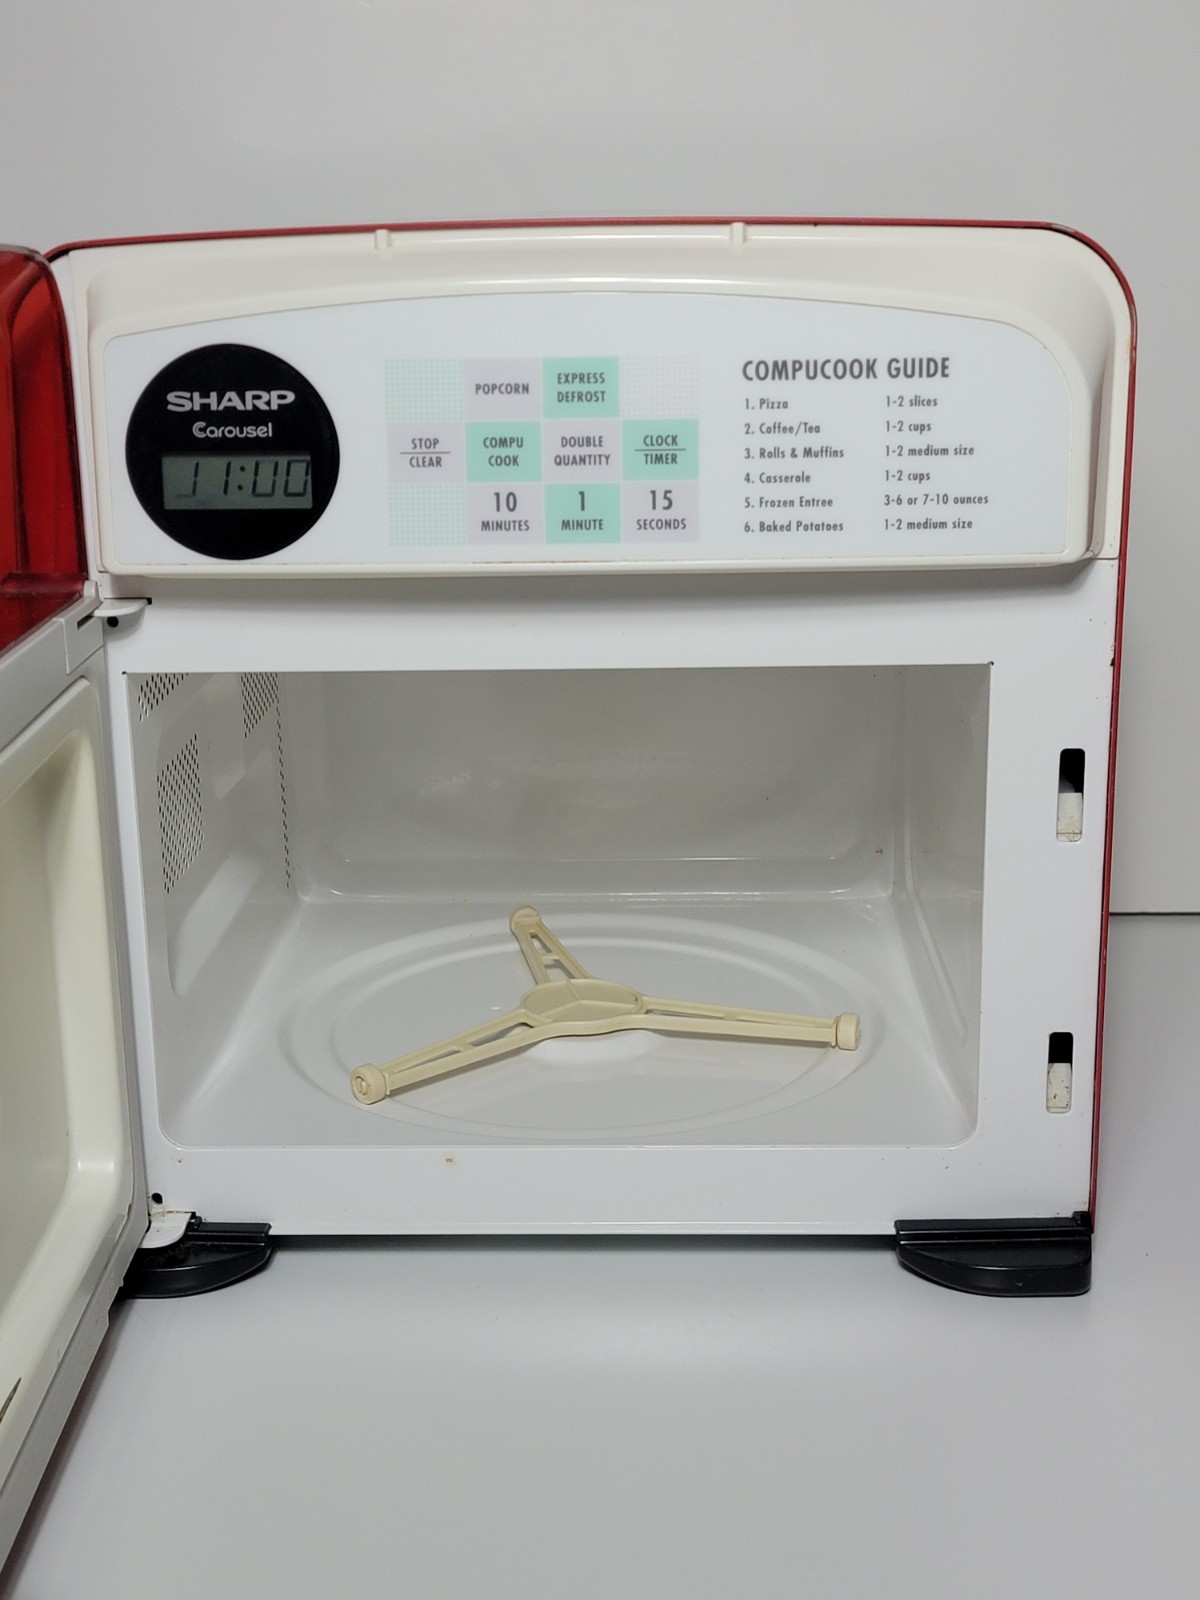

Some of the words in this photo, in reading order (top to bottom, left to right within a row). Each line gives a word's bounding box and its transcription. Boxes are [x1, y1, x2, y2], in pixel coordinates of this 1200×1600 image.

[742, 359, 878, 381] COMPUCOOK
[887, 357, 950, 379] GUIDE
[557, 372, 605, 385] EXPRESS
[475, 383, 529, 395] POPCORN
[167, 390, 295, 412] SHARP
[557, 391, 606, 403] DEFROST
[886, 396, 904, 407] 1-2
[909, 396, 938, 407] slices
[744, 399, 755, 410] 1.
[759, 399, 789, 410] Pizza
[192, 421, 272, 438] Carousel
[744, 423, 755, 435] 2.
[759, 421, 821, 436] Coffee/Tea
[886, 421, 904, 432] 1-2
[908, 422, 932, 435] cups
[411, 438, 439, 450] STOP
[483, 437, 524, 449] COMPU
[561, 436, 604, 447] DOUBLE
[643, 435, 678, 447] CLOCK
[744, 448, 755, 459] 3.
[759, 448, 786, 459] Rolls
[790, 448, 798, 459] &
[803, 447, 844, 458] Muffins
[885, 445, 904, 456] 1-2
[908, 445, 949, 456] medium
[953, 445, 975, 456] size
[409, 456, 442, 468] CLEAR
[488, 455, 519, 467] COOK
[554, 454, 611, 467] QUANTITY
[643, 453, 678, 465] TIMER
[190, 459, 311, 497] 11:00
[744, 473, 755, 484] 4.
[759, 471, 811, 484] Casserole
[885, 470, 903, 481] 1-2
[907, 472, 931, 484] cups
[494, 491, 518, 513] 10
[578, 491, 586, 512] 1
[649, 490, 673, 511] 15
[744, 497, 755, 509] 5.
[759, 497, 795, 508] Frozen
[799, 496, 833, 508] Entree
[884, 494, 903, 506] 3-6
[907, 496, 918, 506] or
[922, 494, 949, 505] 7-10
[953, 495, 989, 505] ounces
[481, 519, 530, 532] MINUTES
[561, 519, 604, 531] MINUTE
[636, 518, 687, 531] SECONDS
[744, 522, 755, 533] 6.
[759, 521, 791, 533] Baked
[796, 520, 844, 532] Potatoes
[884, 519, 903, 530] 1-2
[907, 519, 948, 530] medium
[952, 519, 973, 529] size
